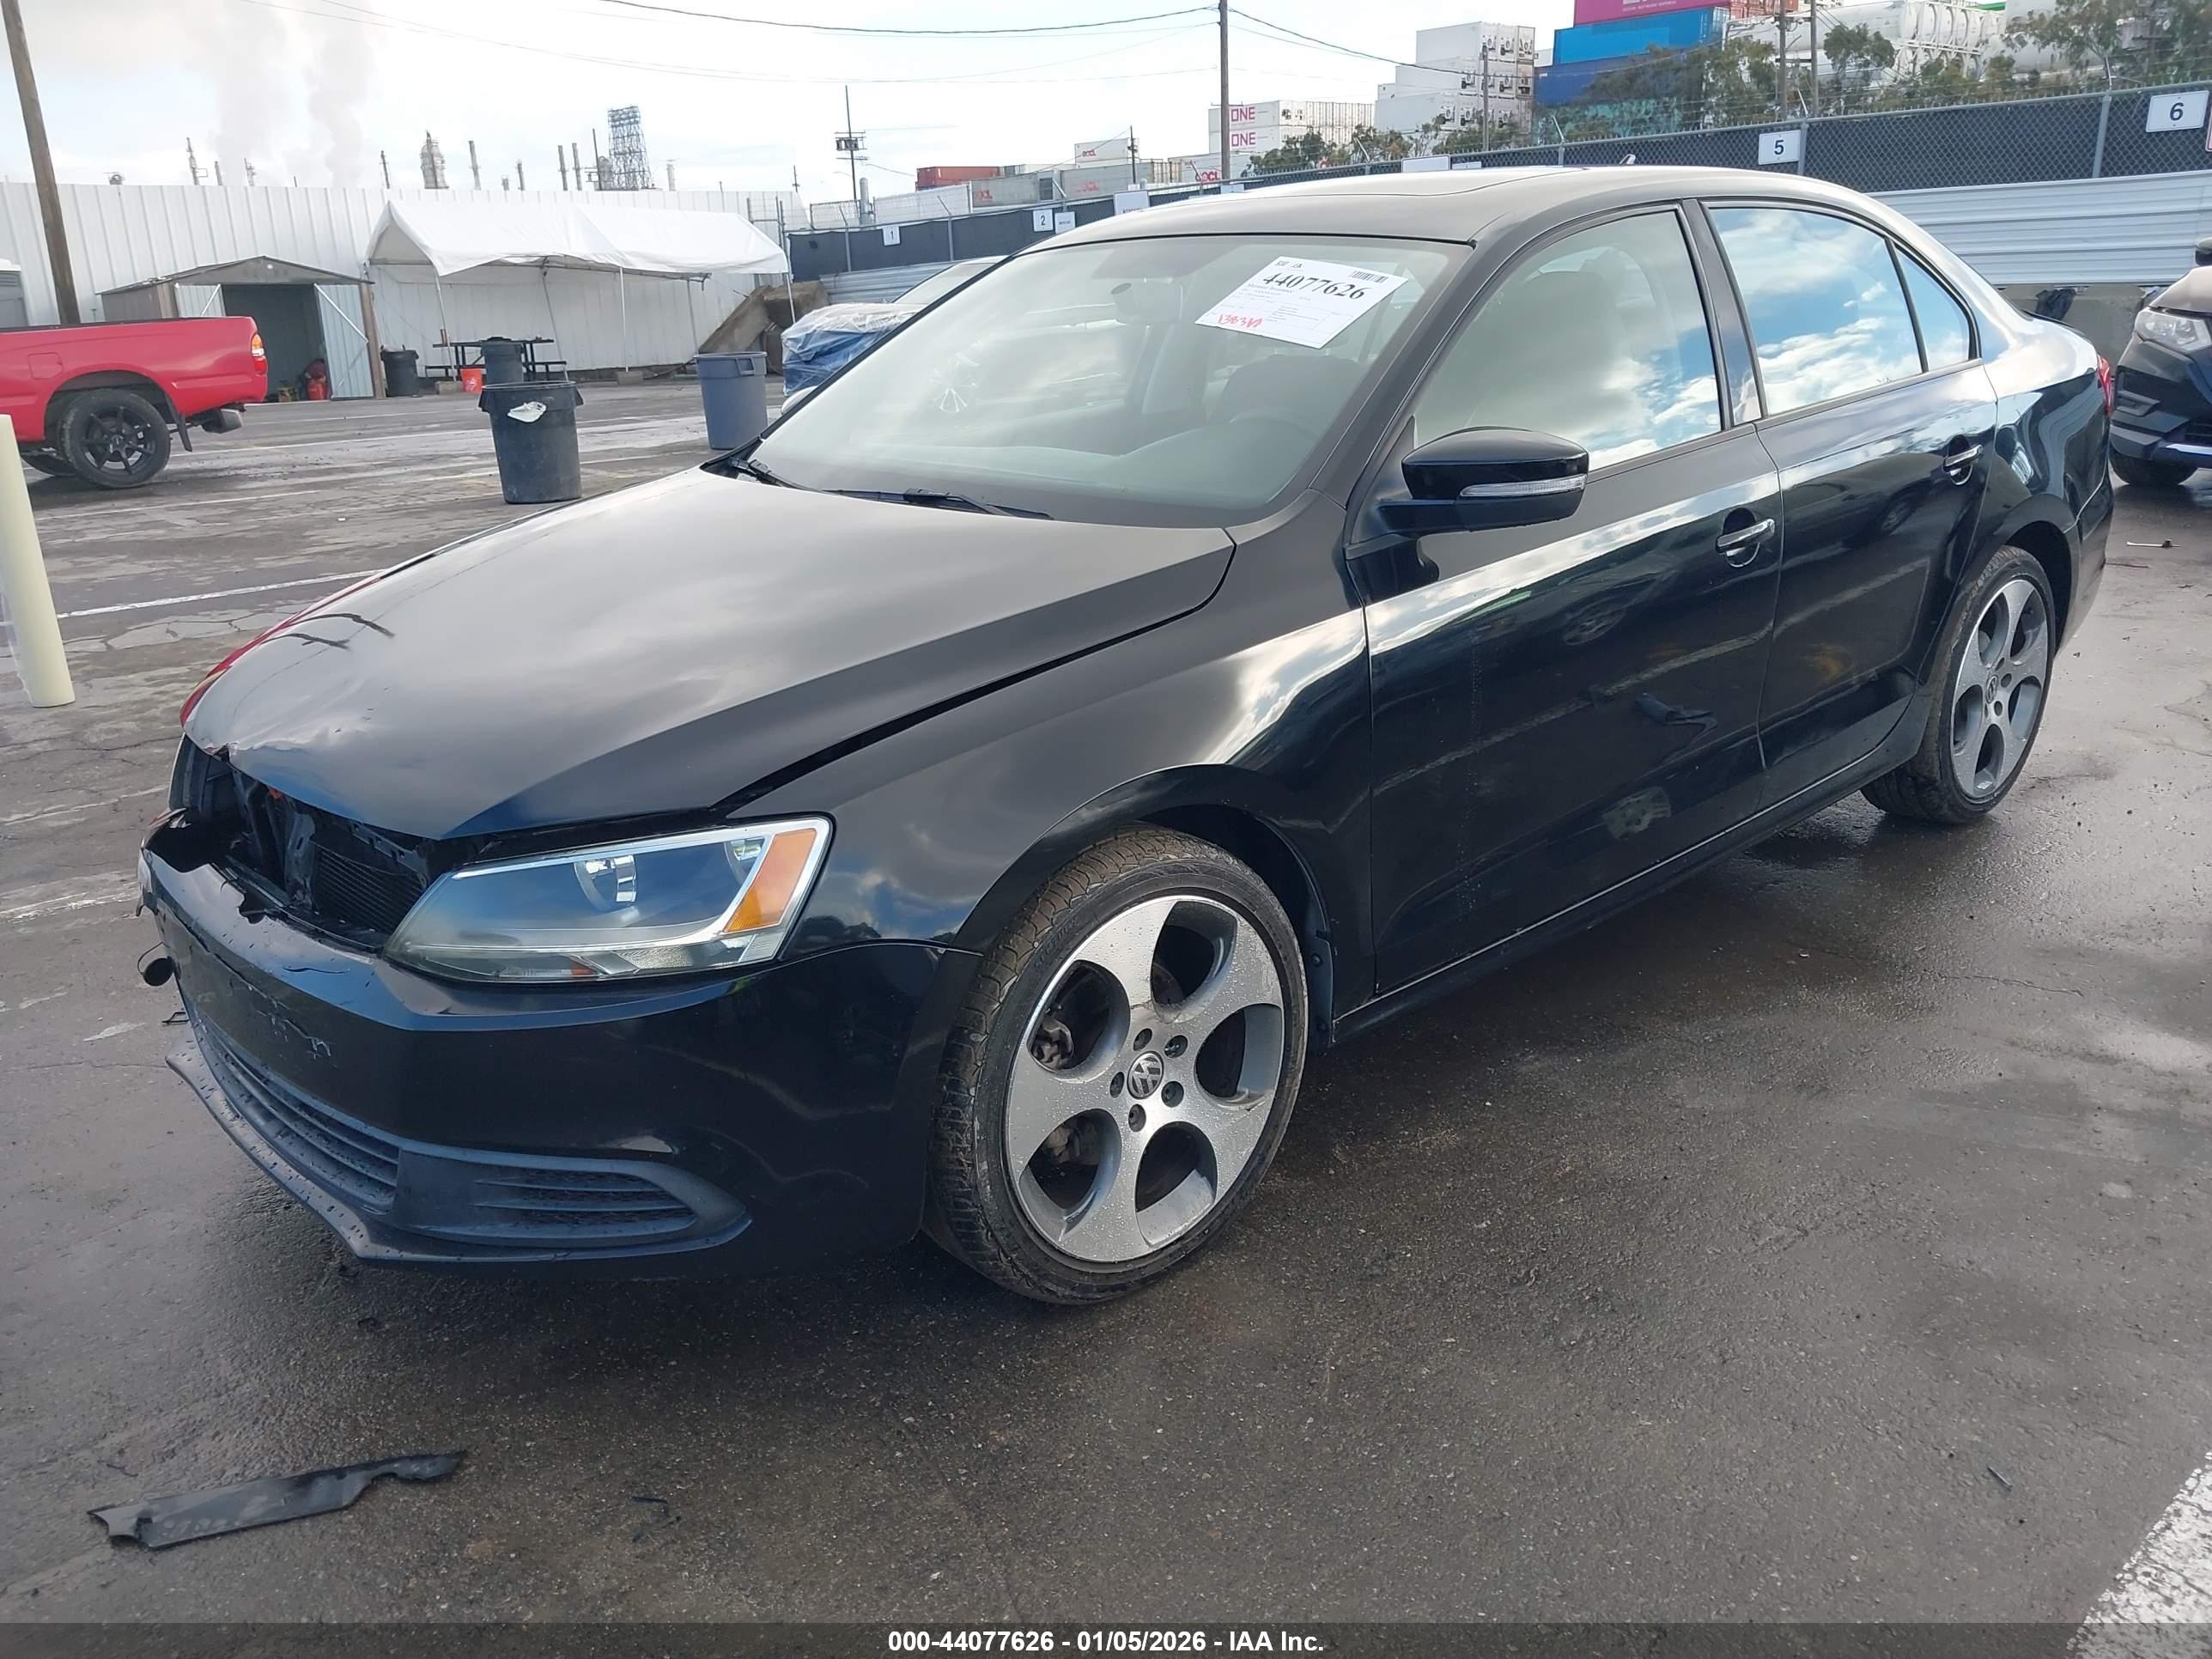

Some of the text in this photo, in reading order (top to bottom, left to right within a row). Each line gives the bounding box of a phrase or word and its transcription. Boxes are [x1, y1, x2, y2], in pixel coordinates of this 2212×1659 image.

[1231, 106, 1255, 122] ONE
[2170, 102, 2185, 121] 6
[1231, 131, 1256, 147] ONE
[1774, 139, 1784, 155] 5
[1040, 215, 1047, 226] 2
[1263, 273, 1372, 299] 44077626
